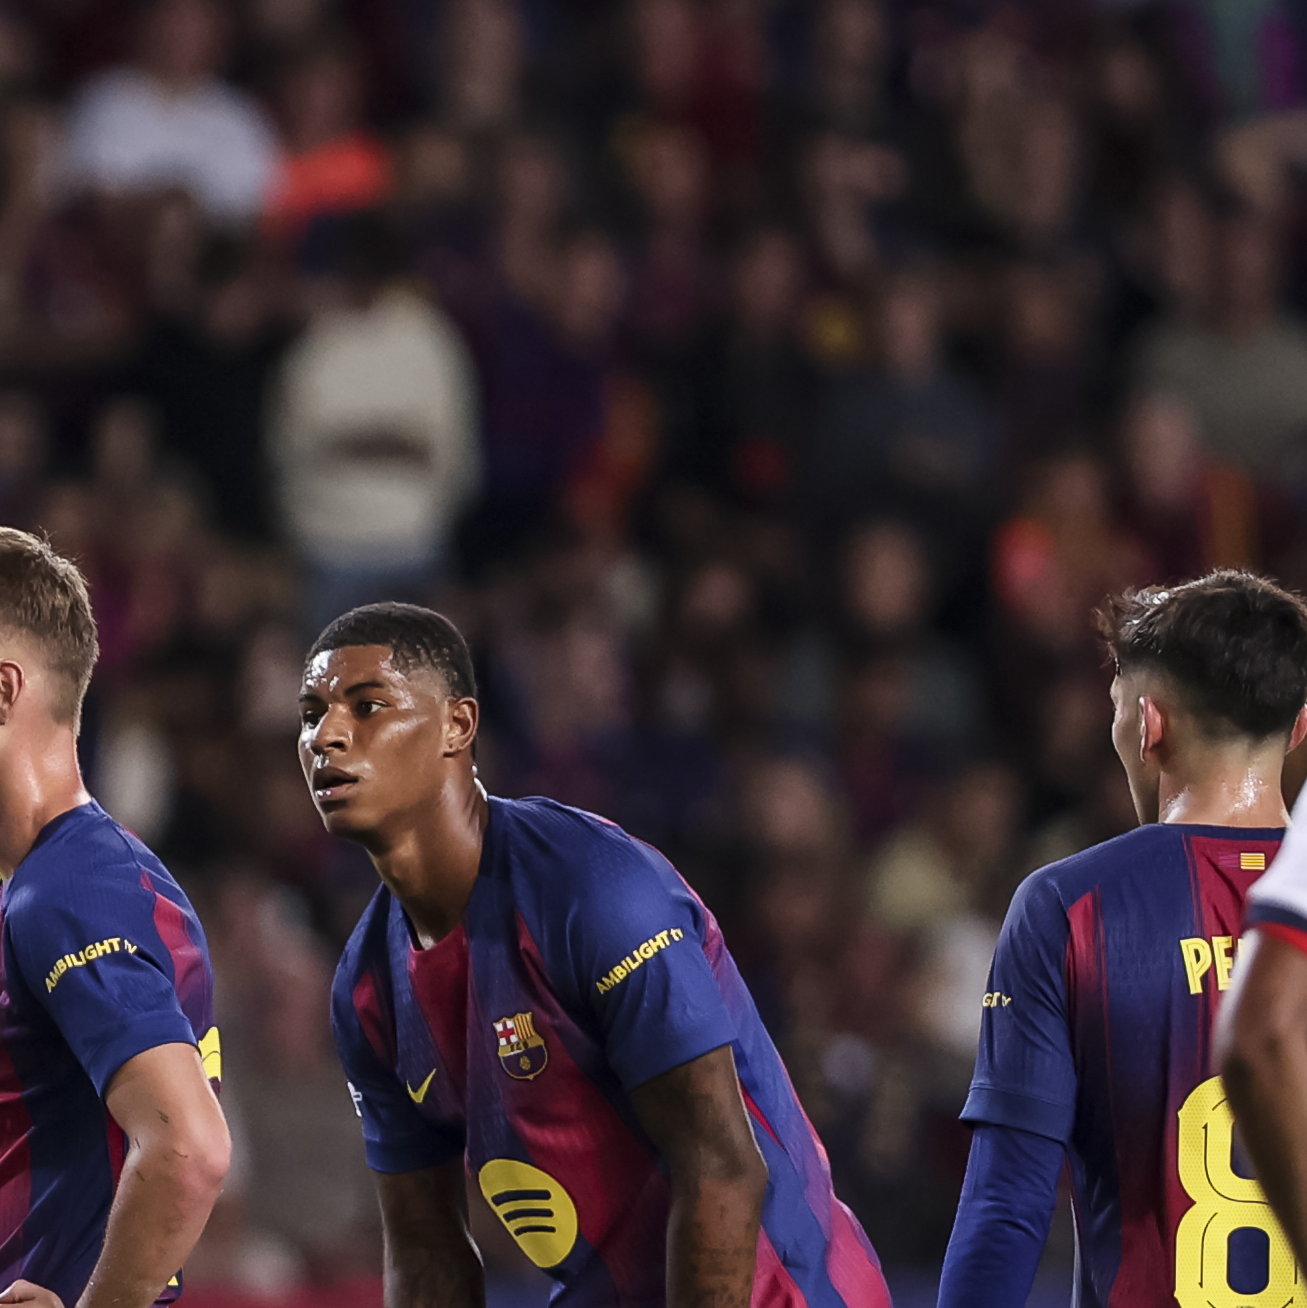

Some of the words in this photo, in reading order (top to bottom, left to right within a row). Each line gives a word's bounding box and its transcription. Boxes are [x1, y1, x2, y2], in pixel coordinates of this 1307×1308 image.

[45, 937, 121, 994] AMBILIGHT
[596, 929, 671, 995] AMBILIGHT
[1180, 935, 1245, 995] PE
